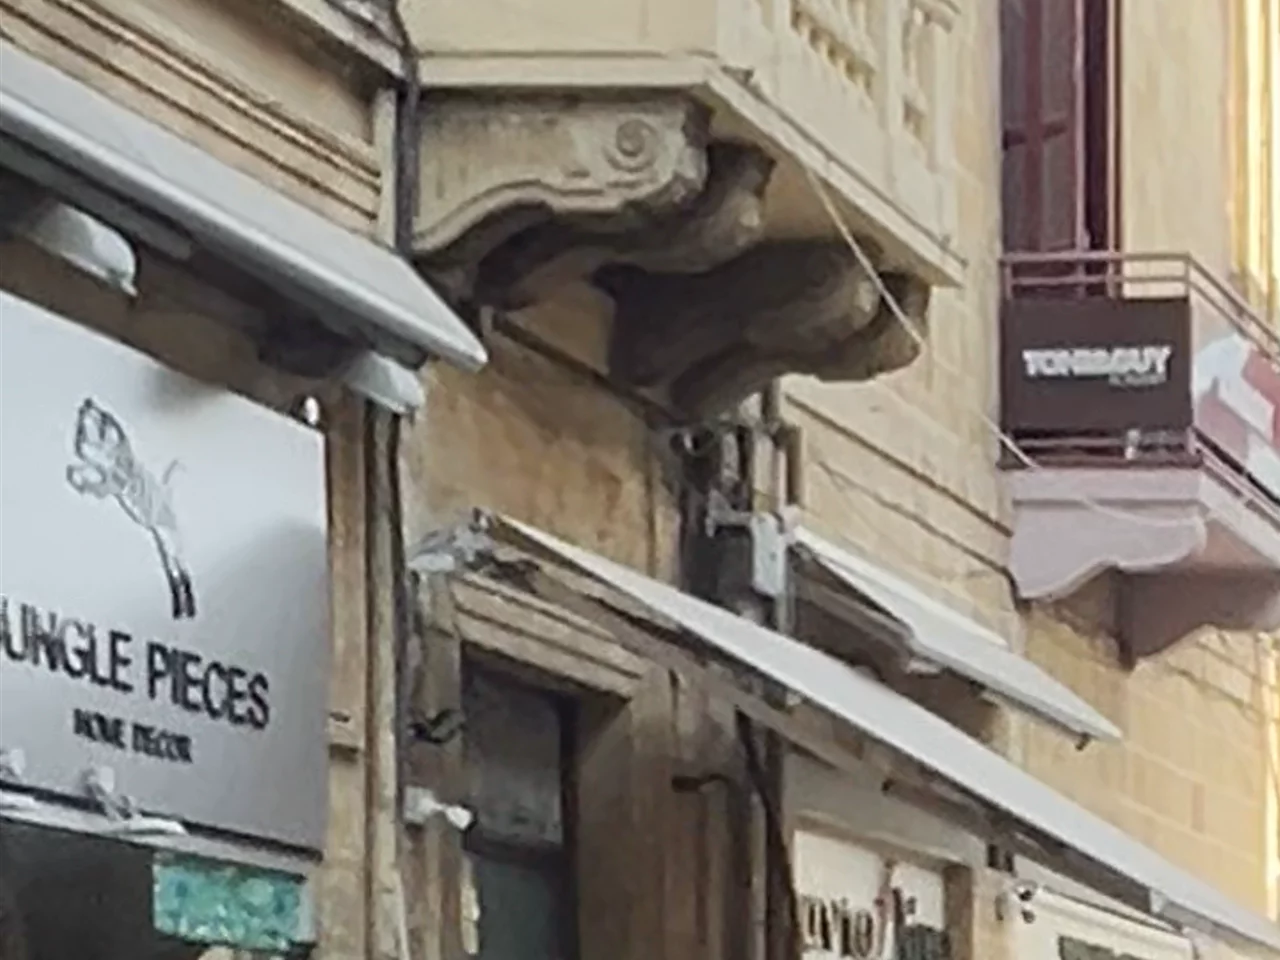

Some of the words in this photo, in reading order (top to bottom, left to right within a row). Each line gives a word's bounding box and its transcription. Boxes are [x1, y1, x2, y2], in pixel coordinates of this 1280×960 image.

[0, 597, 133, 693] UNGLE
[147, 641, 270, 730] PIECES
[131, 722, 193, 763] DECOR
